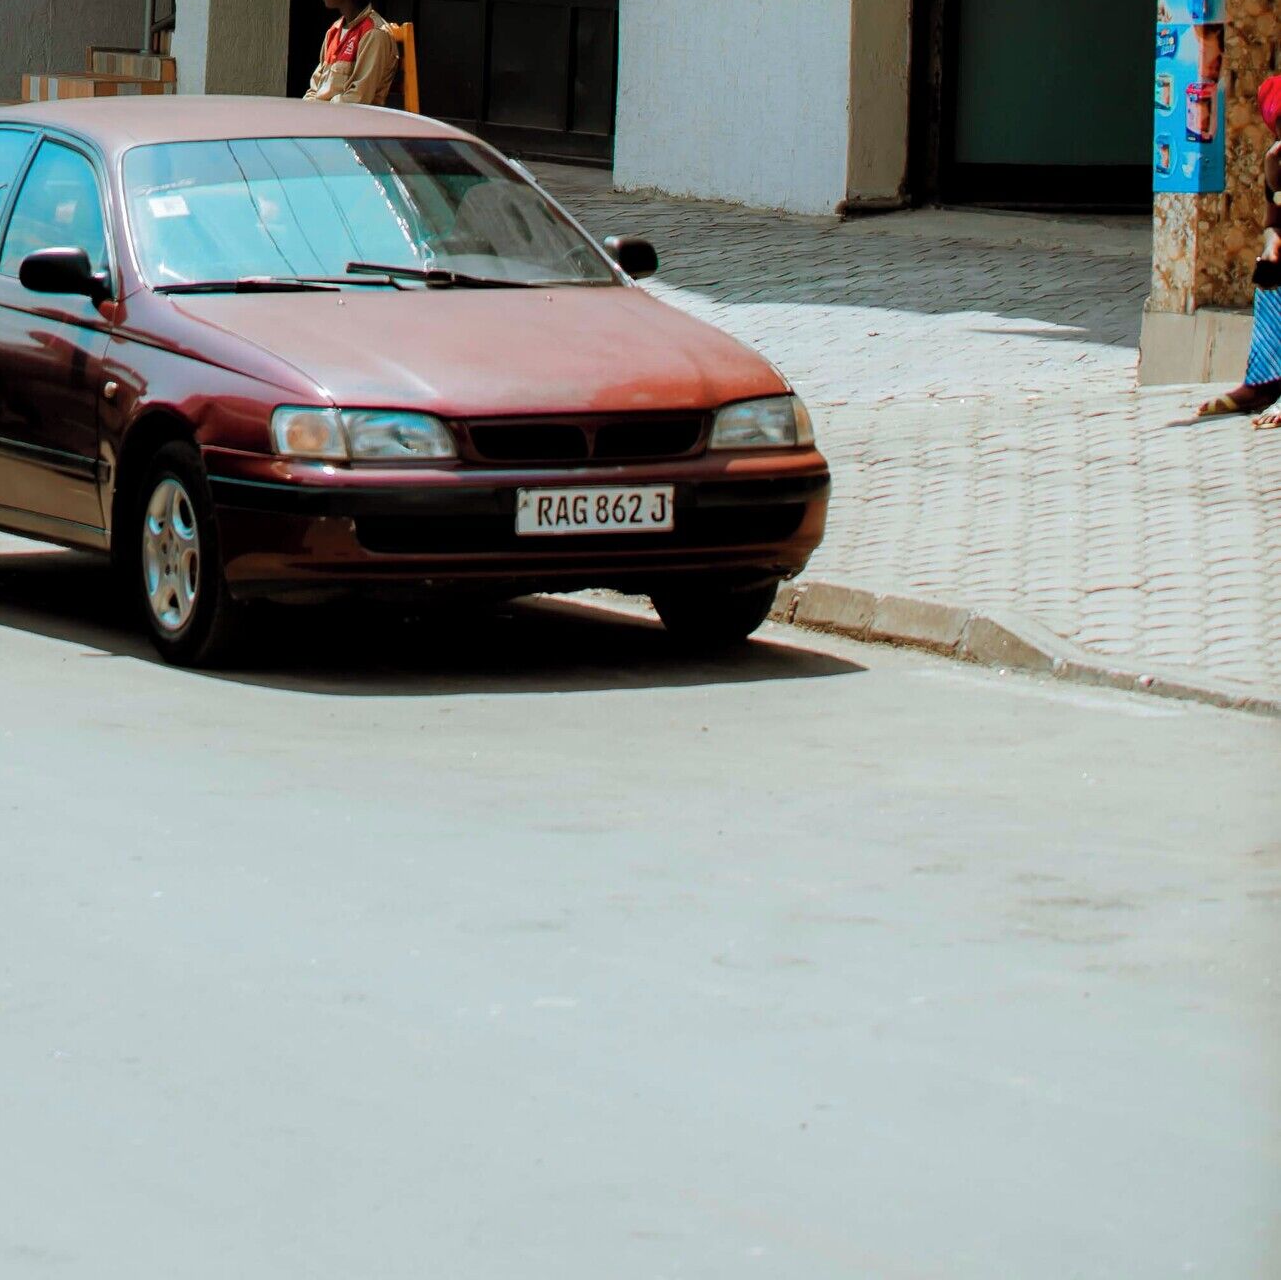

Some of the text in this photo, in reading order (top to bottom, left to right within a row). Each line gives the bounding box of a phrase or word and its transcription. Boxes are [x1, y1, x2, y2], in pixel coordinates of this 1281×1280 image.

[537, 493, 667, 526] RAG 862 J
